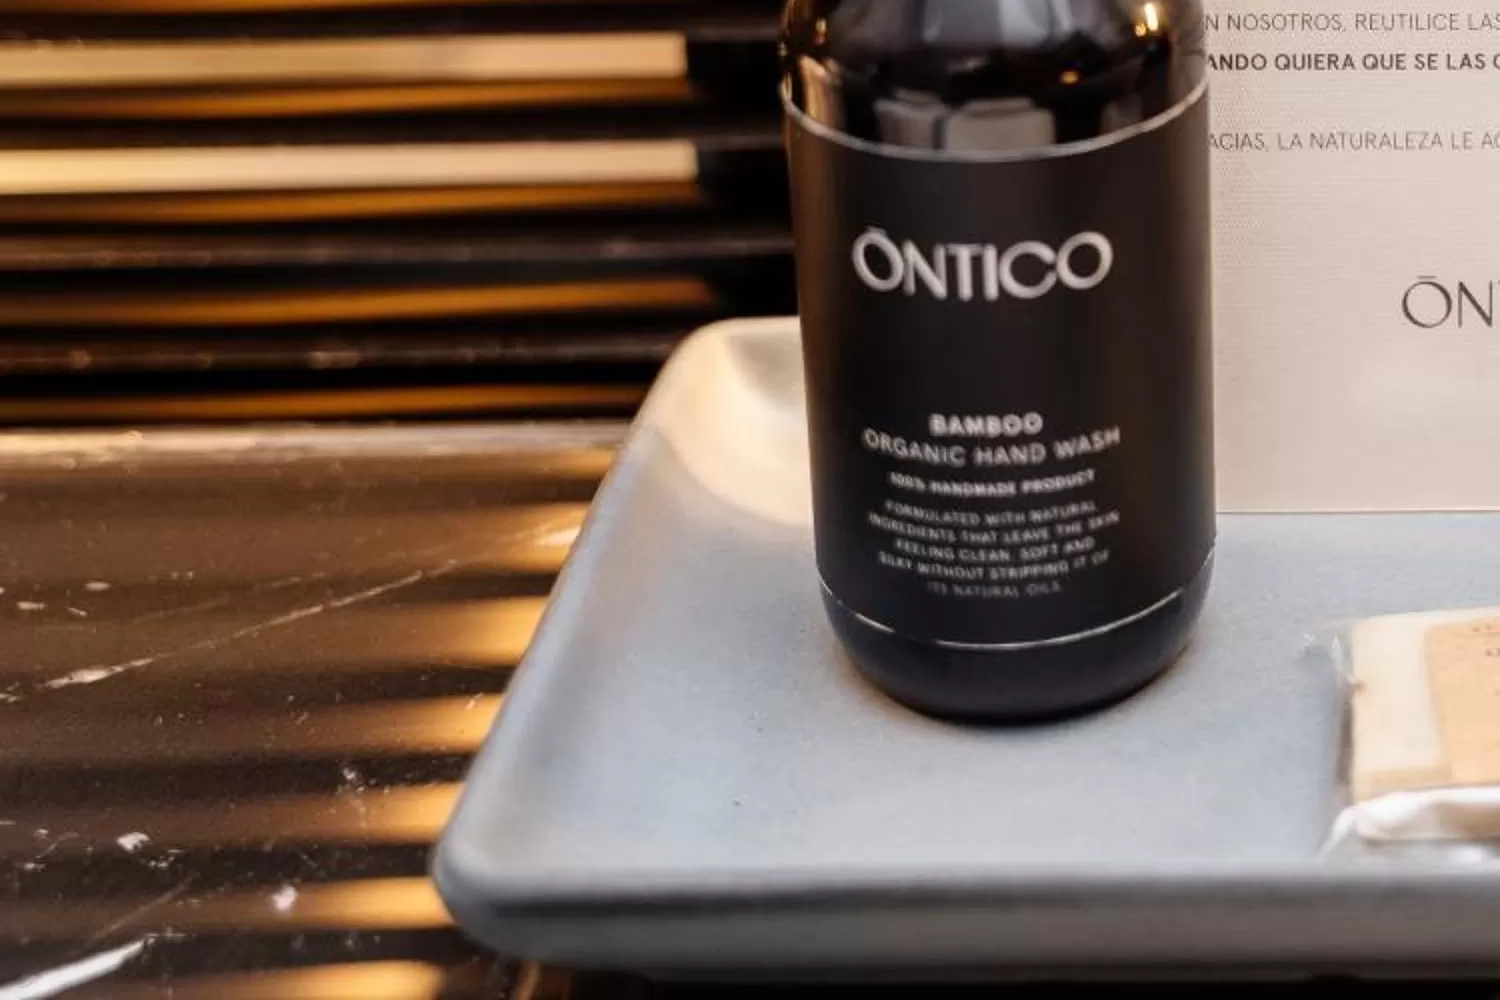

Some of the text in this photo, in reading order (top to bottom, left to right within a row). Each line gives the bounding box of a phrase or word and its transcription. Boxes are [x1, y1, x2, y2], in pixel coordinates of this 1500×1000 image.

[1354, 12, 1460, 32] REUTILICE
[1208, 53, 1268, 71] ANDO
[1274, 53, 1355, 71] QUIERA
[1362, 53, 1406, 71] QUE
[1414, 52, 1438, 71] SE
[1446, 53, 1486, 70] LAS
[1210, 132, 1269, 153] ACIAS,
[1277, 132, 1303, 151] LA
[1309, 130, 1443, 151] NATURALEZA
[1450, 131, 1472, 150] LE
[928, 412, 1043, 438] BAMBOO
[862, 424, 1121, 467] ORGANIC HAND WASH
[929, 480, 1016, 497] HANDMADE
[1020, 468, 1095, 493] PRODUCT
